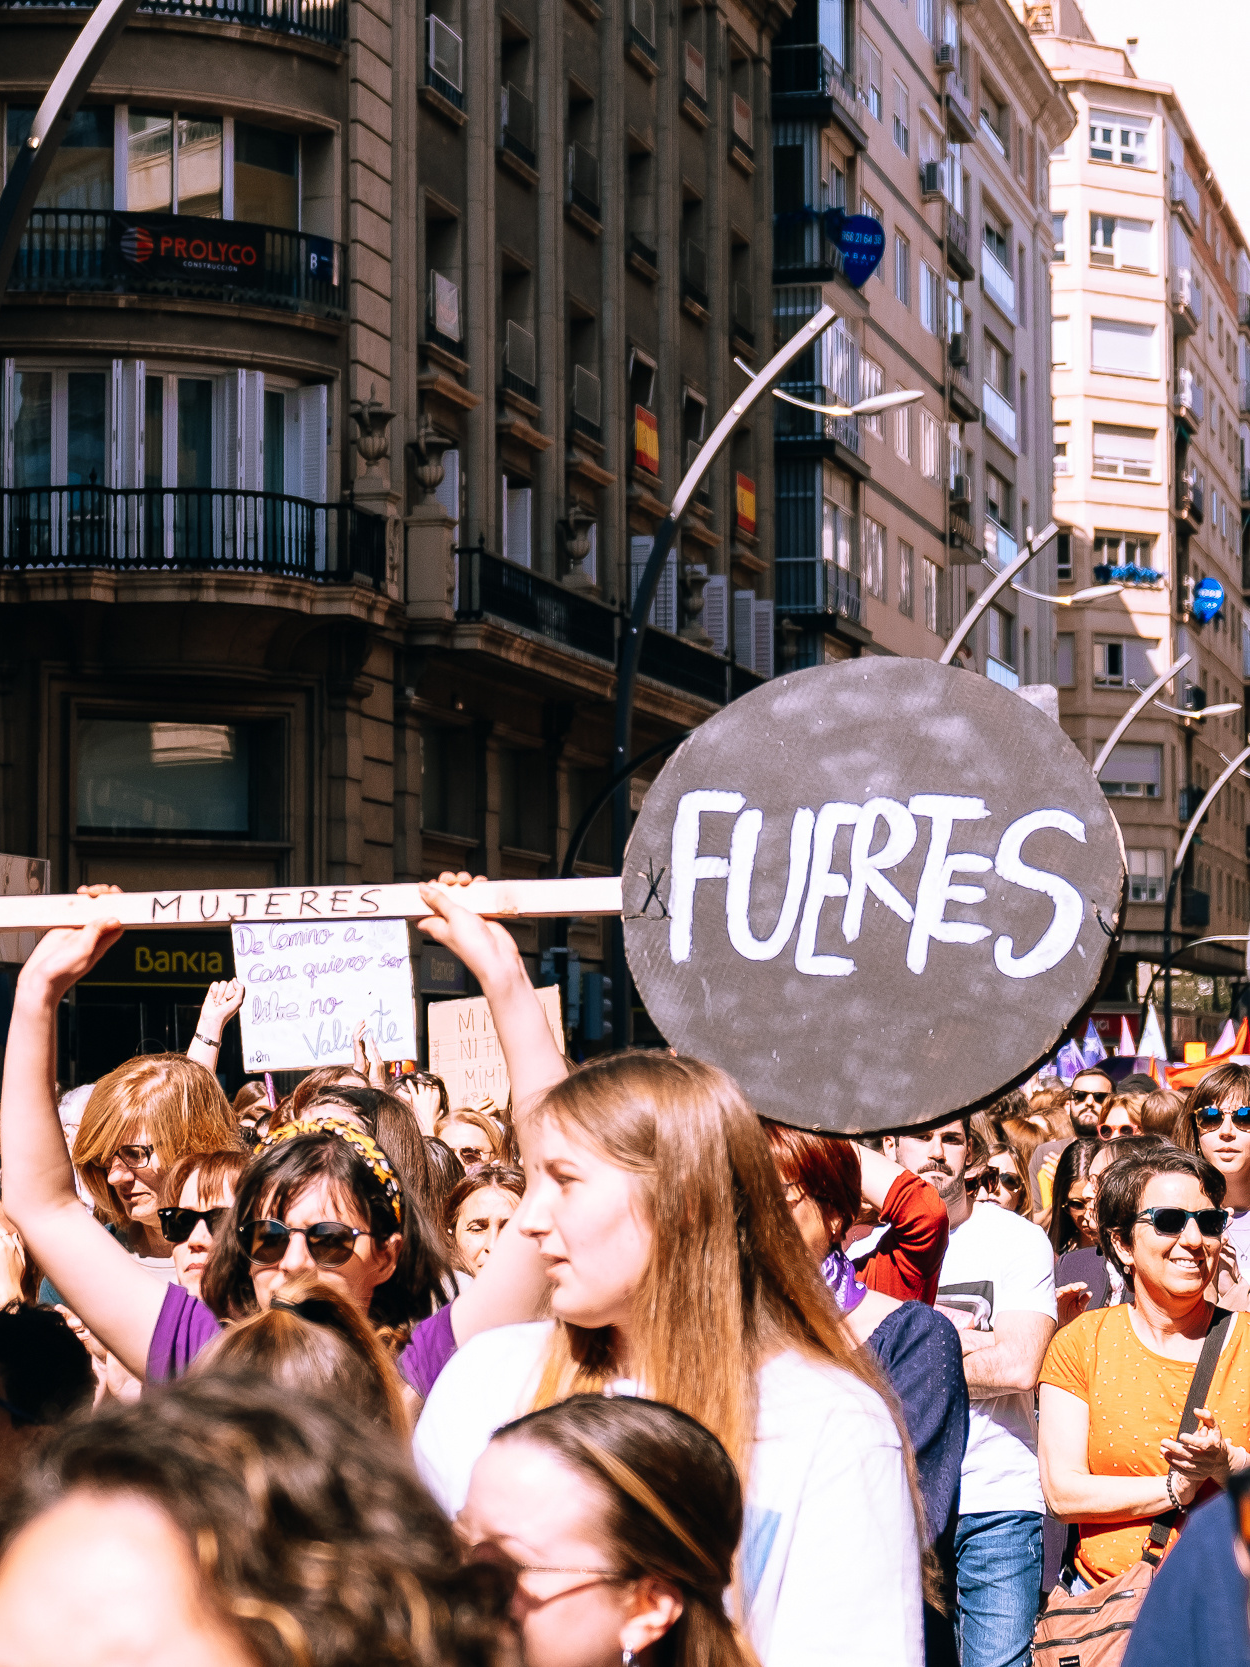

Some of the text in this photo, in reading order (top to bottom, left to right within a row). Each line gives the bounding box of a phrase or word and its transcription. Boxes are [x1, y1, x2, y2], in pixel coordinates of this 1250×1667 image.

[160, 236, 257, 265] PROLYCO
[668, 788, 1088, 979] FUERTES
[152, 889, 381, 920] MUJERES
[234, 926, 265, 957] De
[343, 927, 364, 943] a
[135, 946, 223, 973] Bankia
[302, 955, 373, 988] quiero
[251, 991, 343, 1025] libre no
